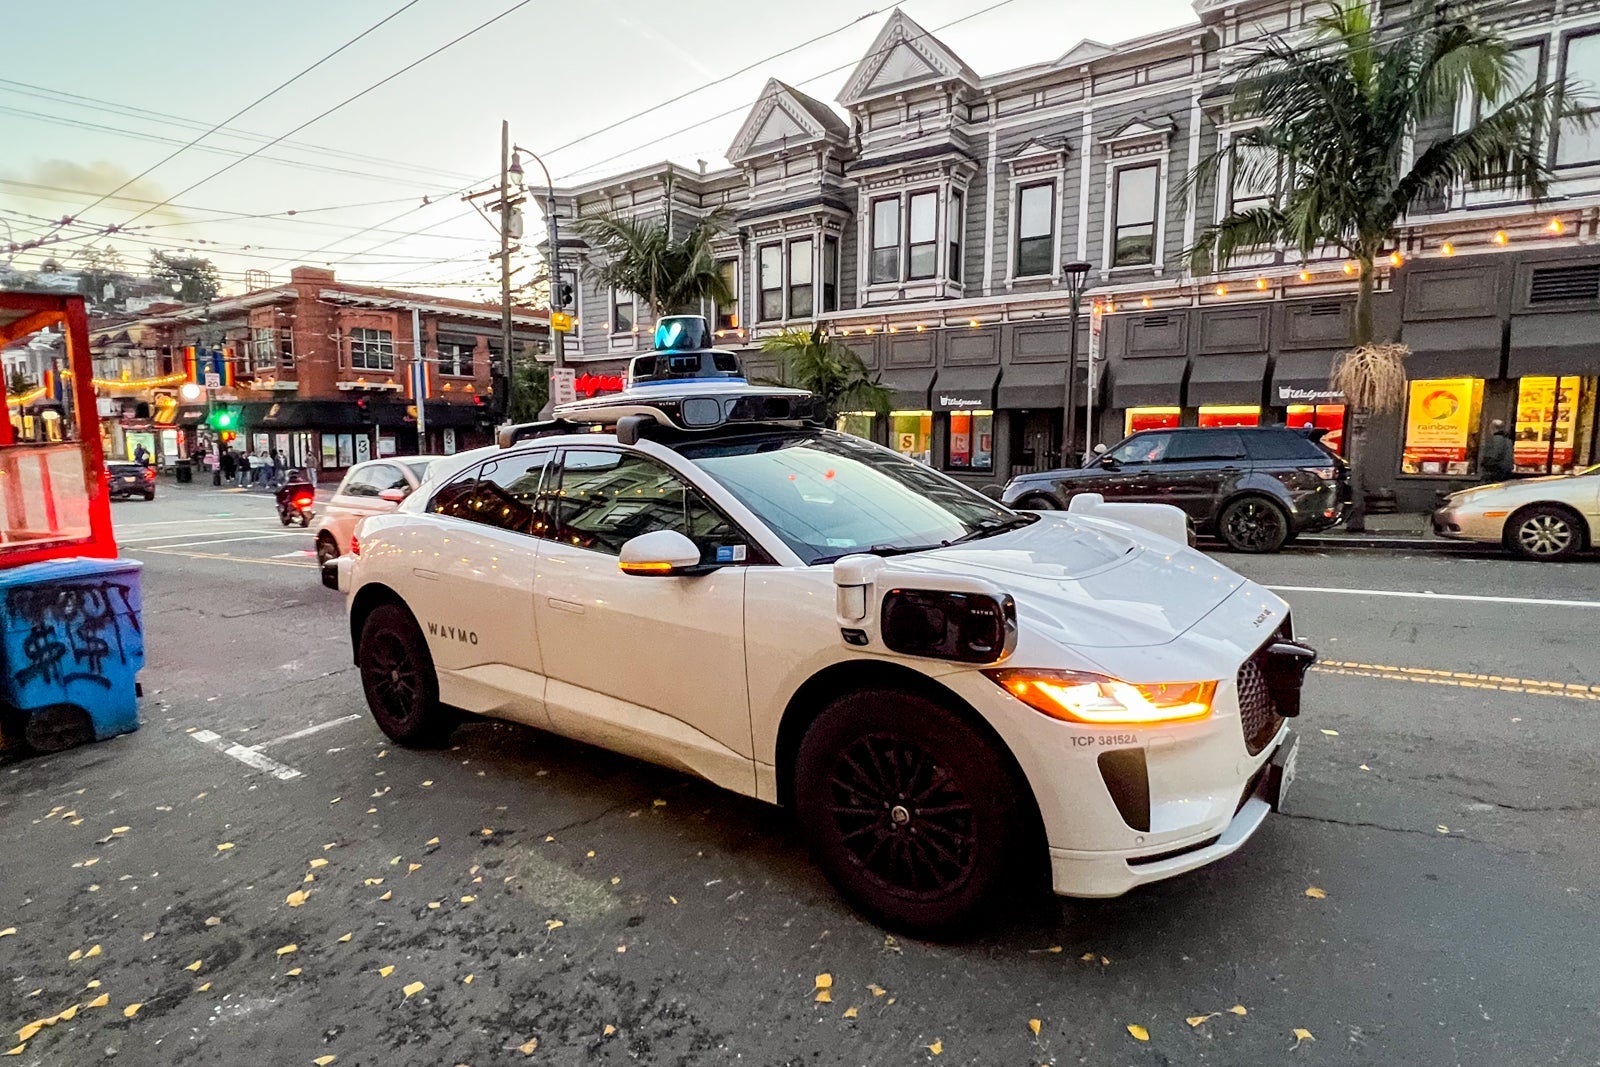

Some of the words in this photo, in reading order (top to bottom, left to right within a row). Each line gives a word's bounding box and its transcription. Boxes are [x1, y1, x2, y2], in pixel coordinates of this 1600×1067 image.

[207, 380, 219, 388] 20
[1290, 388, 1345, 401] Walgreens
[1417, 422, 1458, 431] rainbow
[427, 621, 480, 646] WAYMO
[1070, 736, 1095, 747] TCP
[1098, 735, 1138, 746] 38152A
